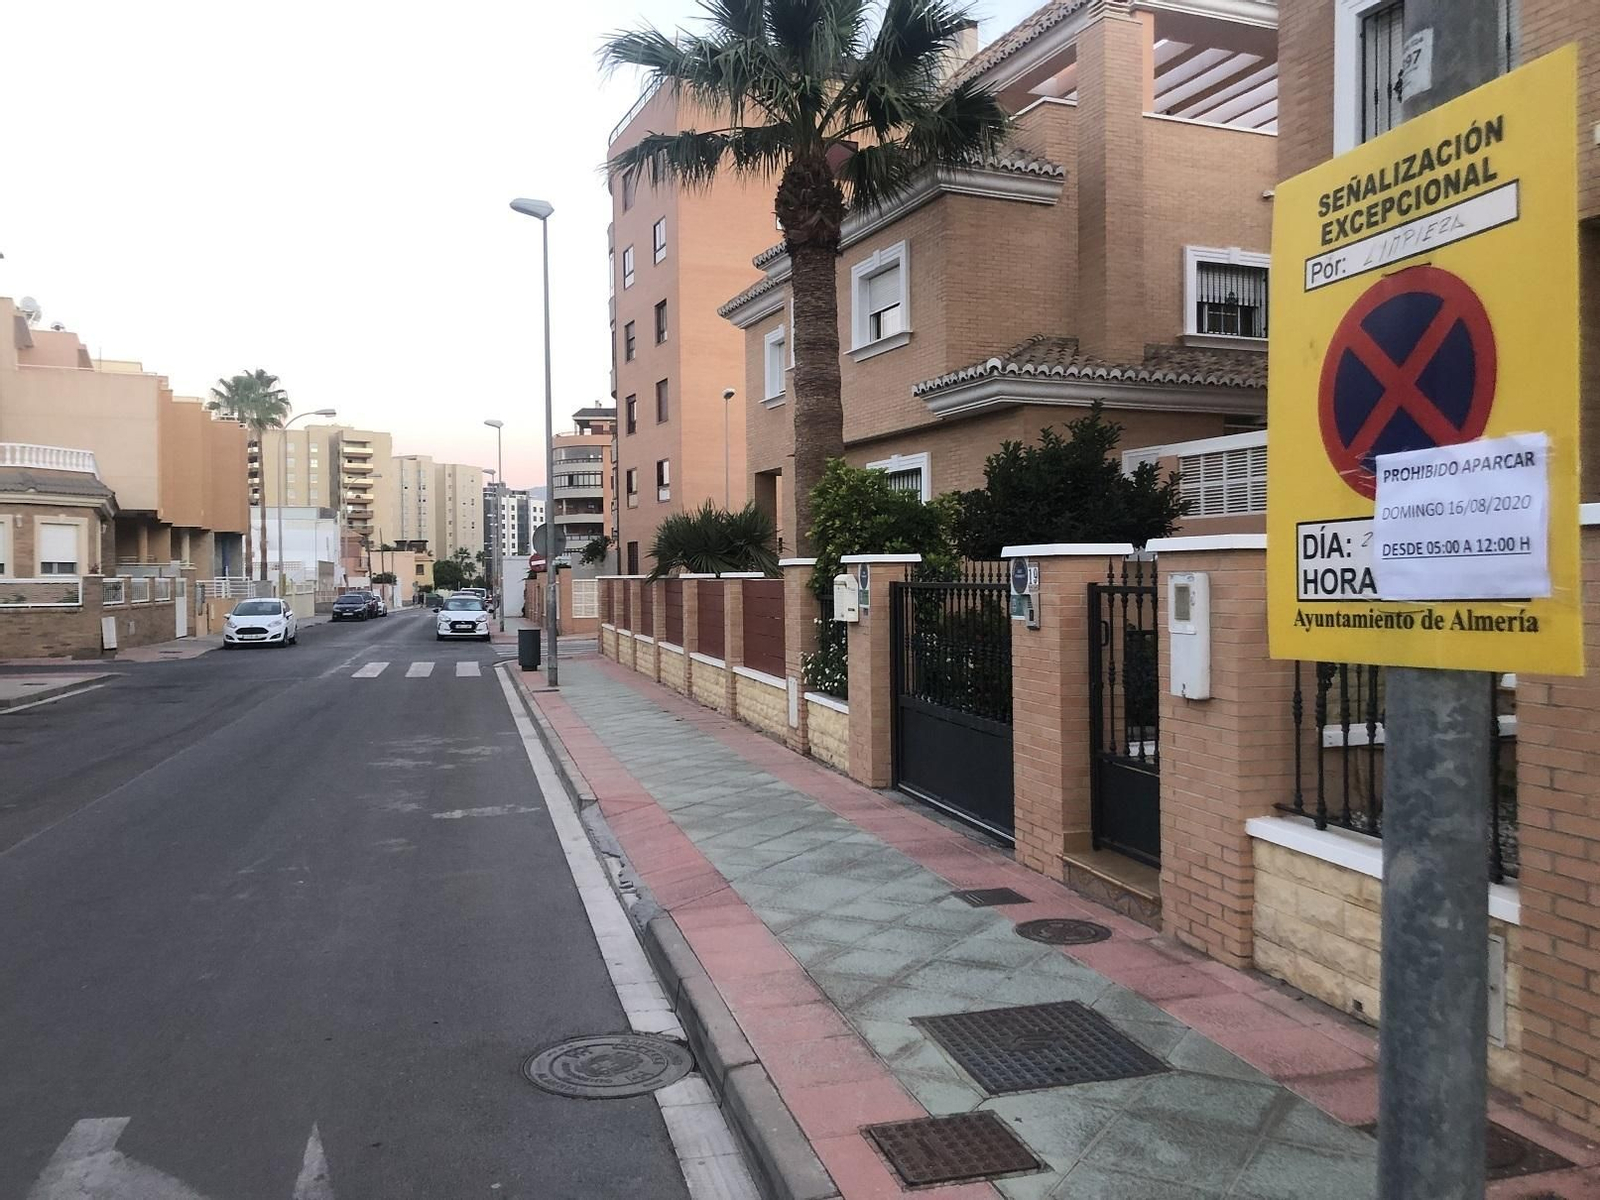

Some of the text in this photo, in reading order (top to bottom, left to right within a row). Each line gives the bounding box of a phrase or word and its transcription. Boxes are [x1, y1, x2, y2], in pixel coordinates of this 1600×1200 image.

[1318, 114, 1504, 218] SEÑALIZACIÓN
[1321, 156, 1497, 246] EXCEPCIONAL
[1310, 257, 1346, 284] Por:
[1383, 451, 1535, 483] PROHIBIDO APARCAR
[1382, 494, 1532, 520] DOMINGO 16/08/2020
[1302, 525, 1352, 560] DÍA:
[1382, 536, 1531, 557] DESDE 05:00 A 12:00 H
[1303, 567, 1378, 595] HORA
[1293, 607, 1540, 633] Ayuntamiento de Almería
